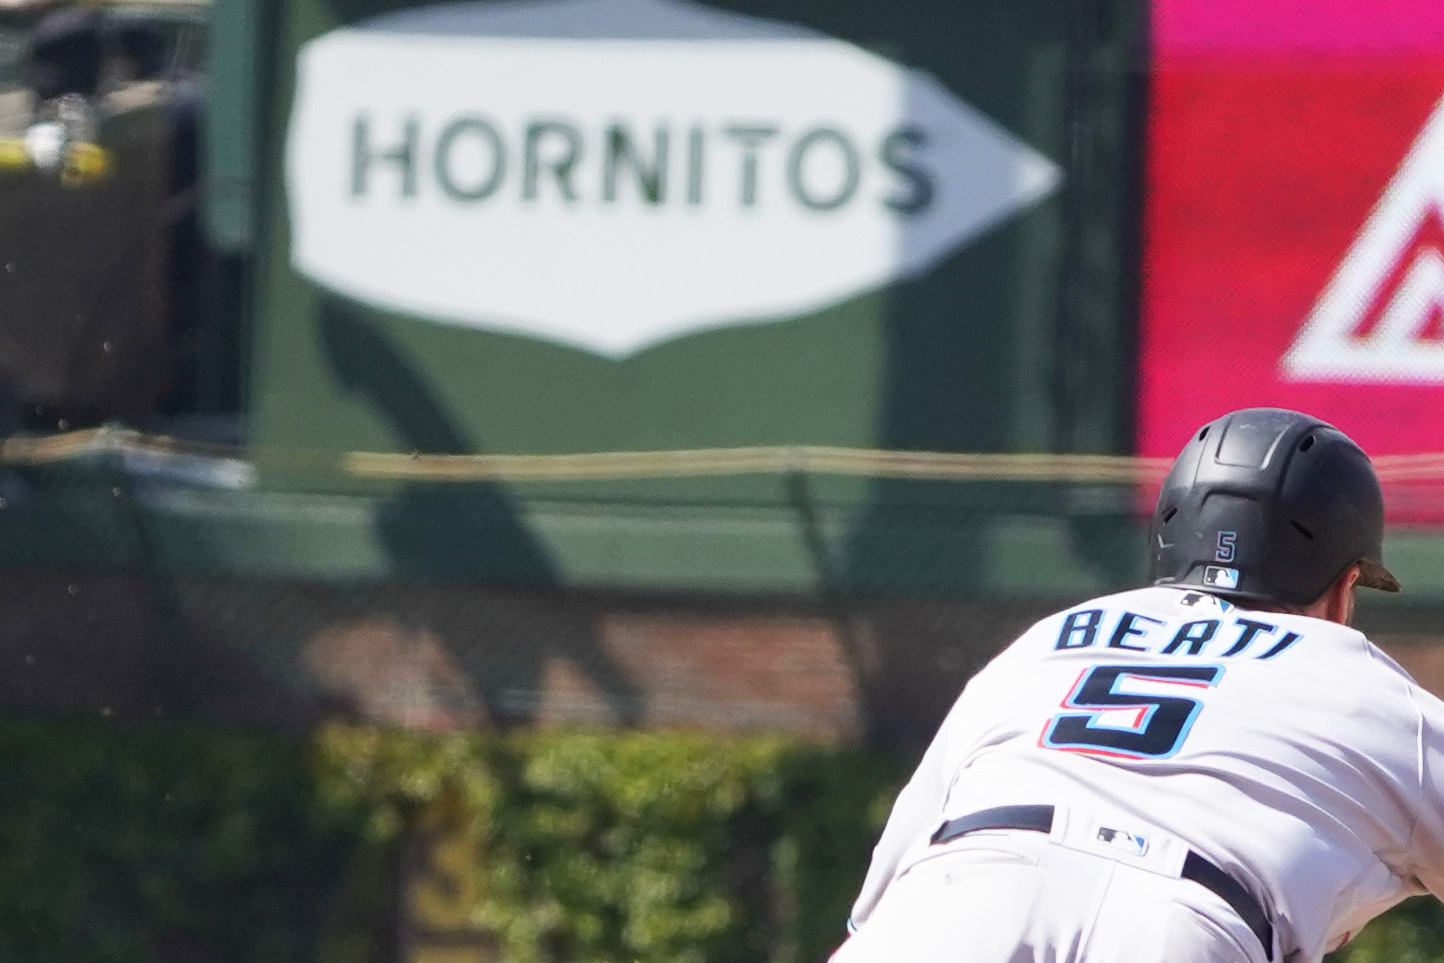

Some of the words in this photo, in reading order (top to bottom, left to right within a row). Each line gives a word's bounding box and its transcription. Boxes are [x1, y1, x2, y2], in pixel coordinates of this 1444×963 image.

[349, 112, 938, 215] HORNITOS
[1214, 530, 1238, 563] 5
[1052, 607, 1305, 661] BERTI
[1036, 663, 1227, 761] 5
